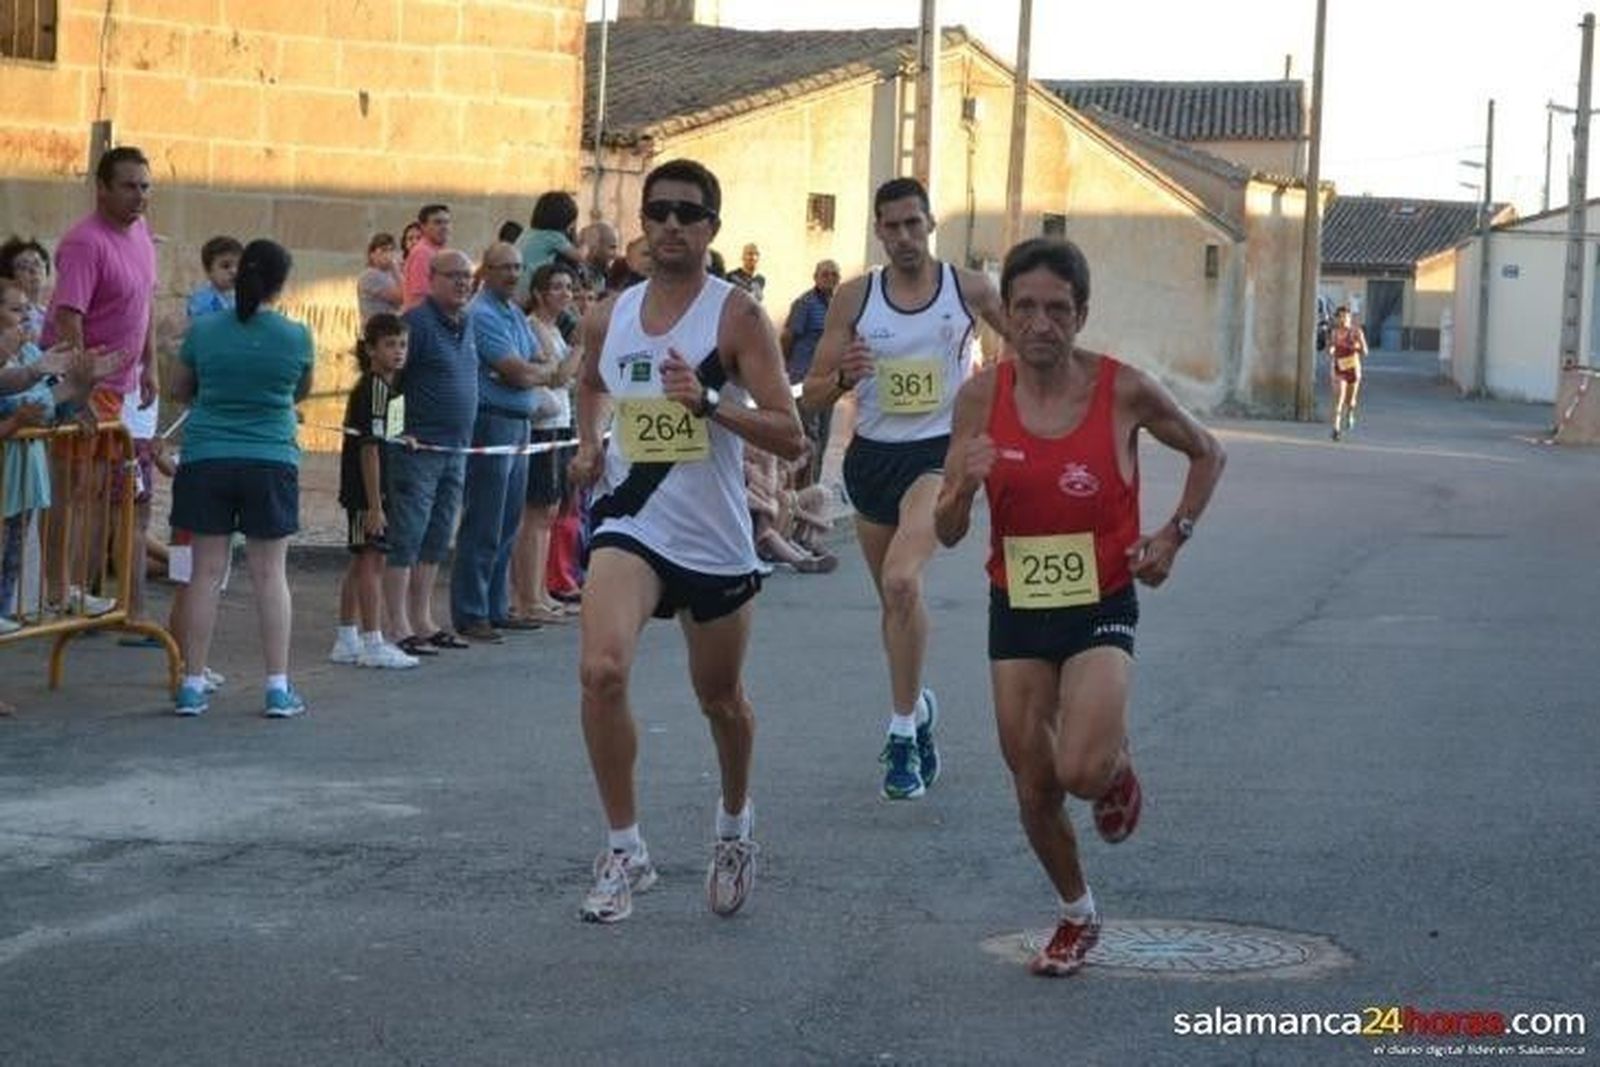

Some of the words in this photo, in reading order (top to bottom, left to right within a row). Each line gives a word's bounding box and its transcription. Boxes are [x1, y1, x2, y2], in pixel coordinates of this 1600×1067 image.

[890, 373, 935, 397] 361
[636, 413, 695, 442] 264
[1022, 552, 1084, 585] 259
